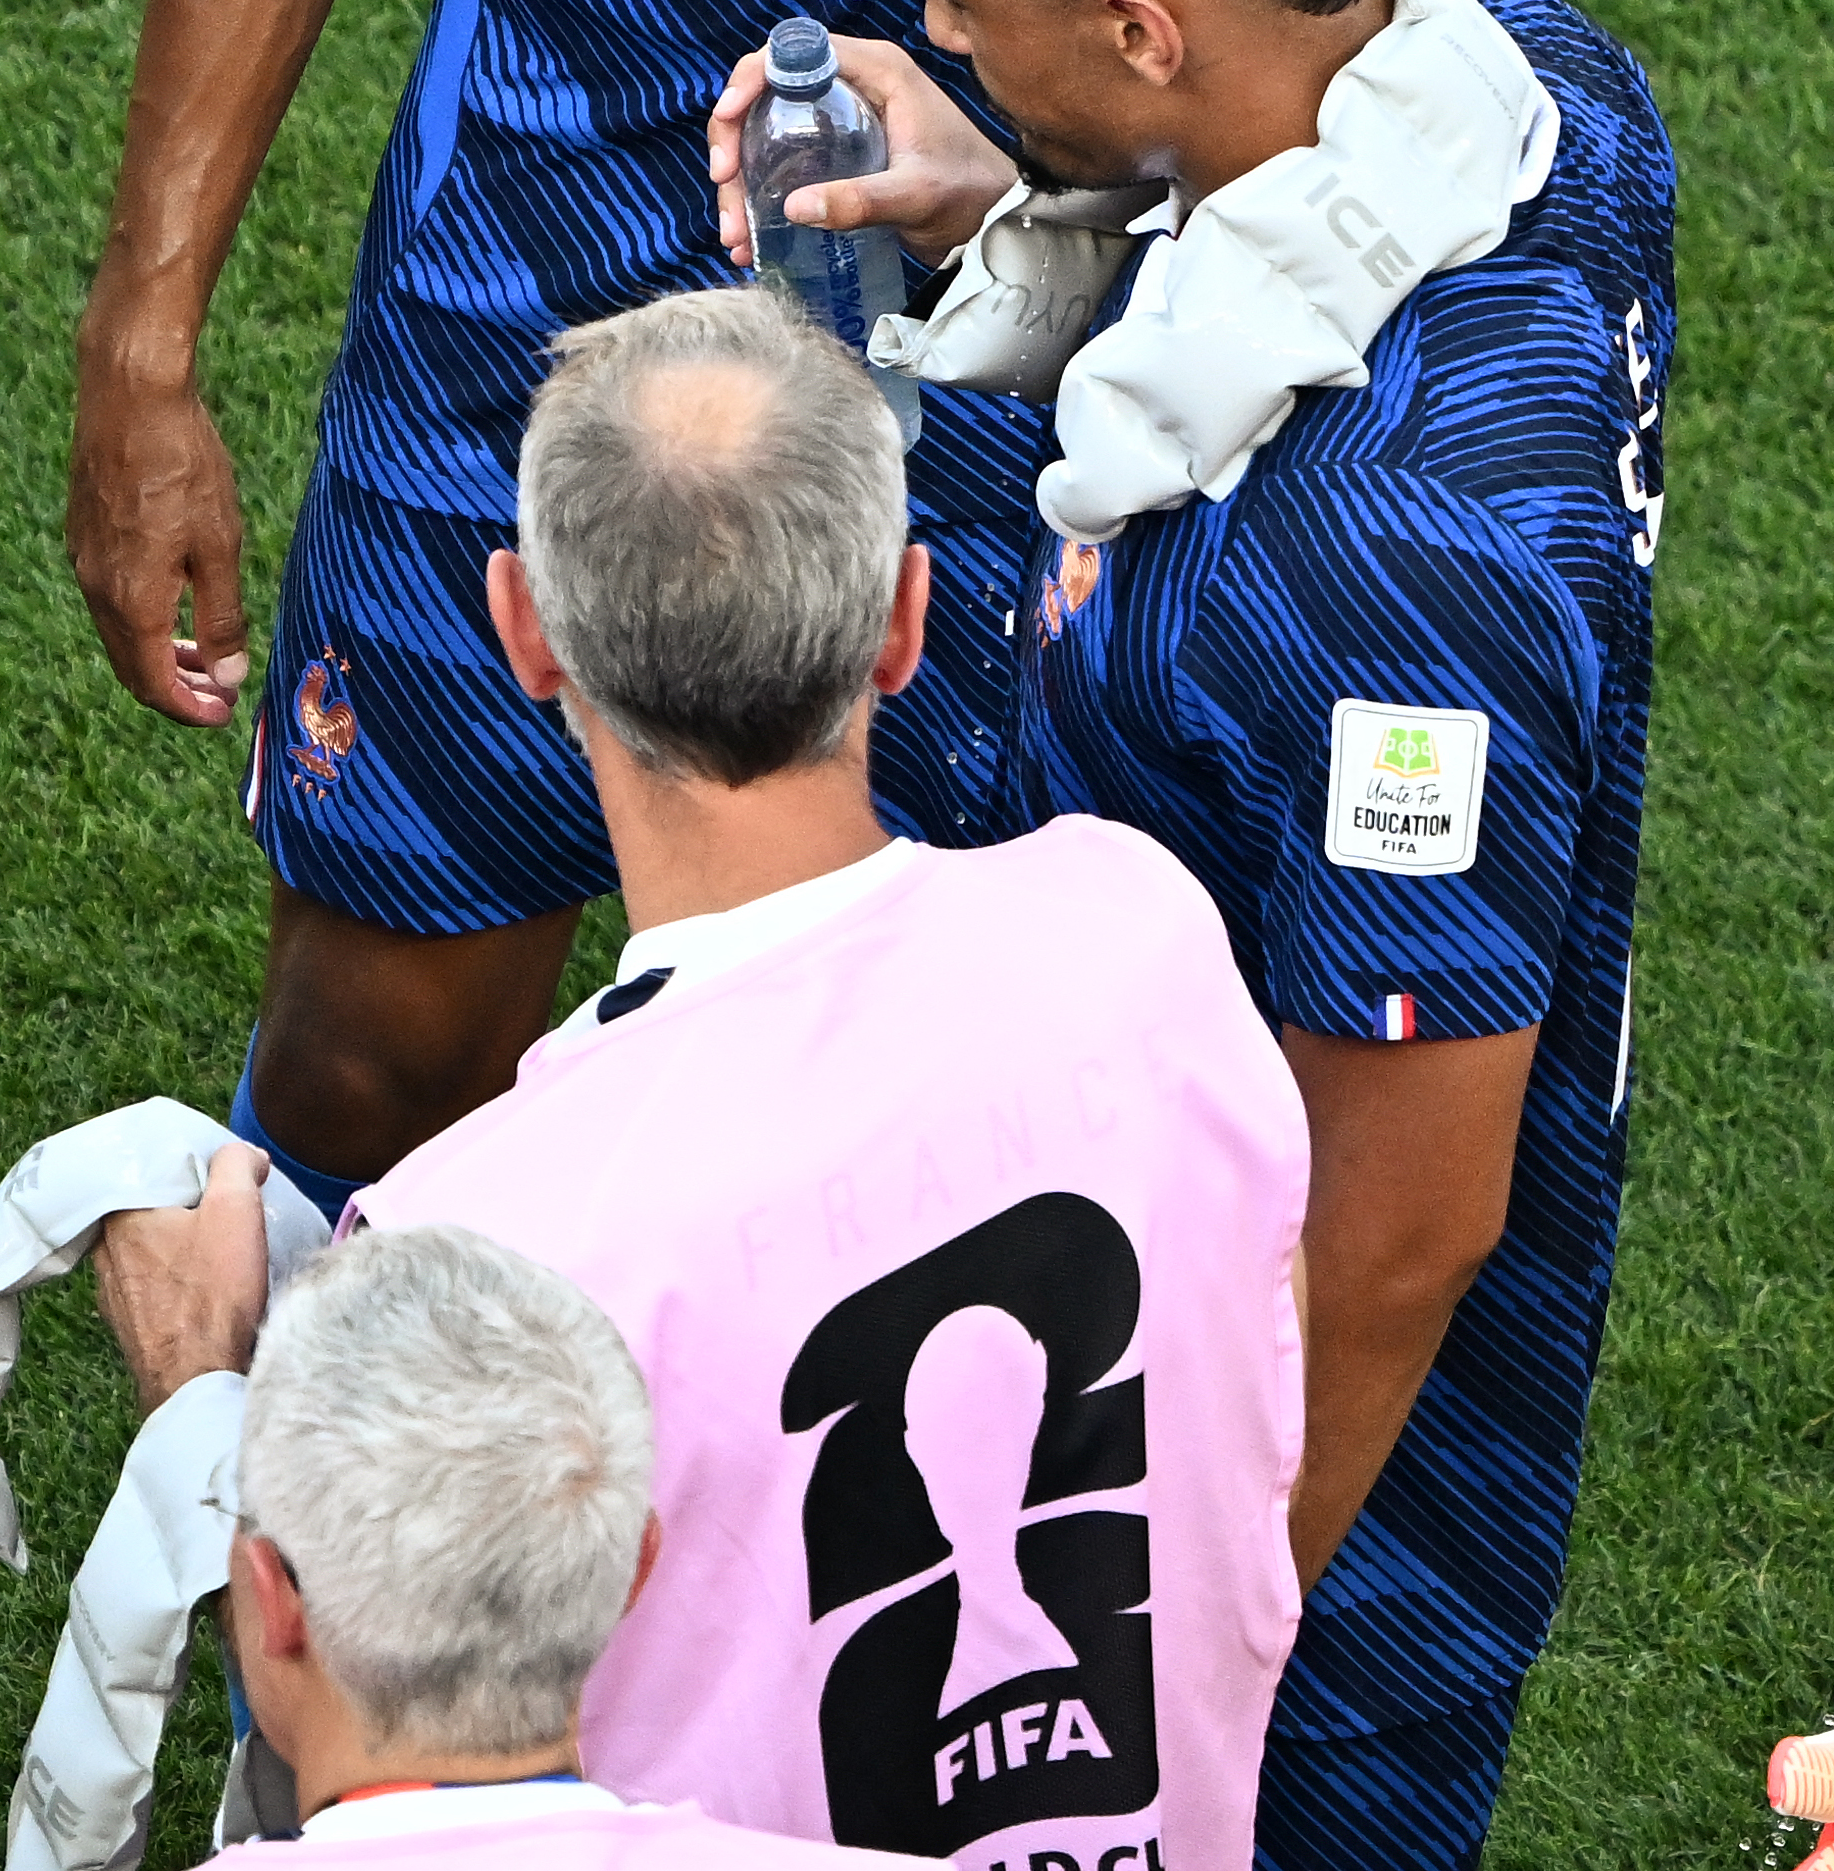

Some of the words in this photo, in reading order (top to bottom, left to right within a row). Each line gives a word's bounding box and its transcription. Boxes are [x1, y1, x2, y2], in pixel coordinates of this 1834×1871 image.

[1303, 172, 1417, 289] ICE
[1366, 777, 1414, 806] Unite
[1415, 783, 1442, 809] For
[1353, 806, 1452, 837] EDUCATION
[1382, 839, 1417, 854] FIFA
[933, 1697, 1114, 1807] FIFA
